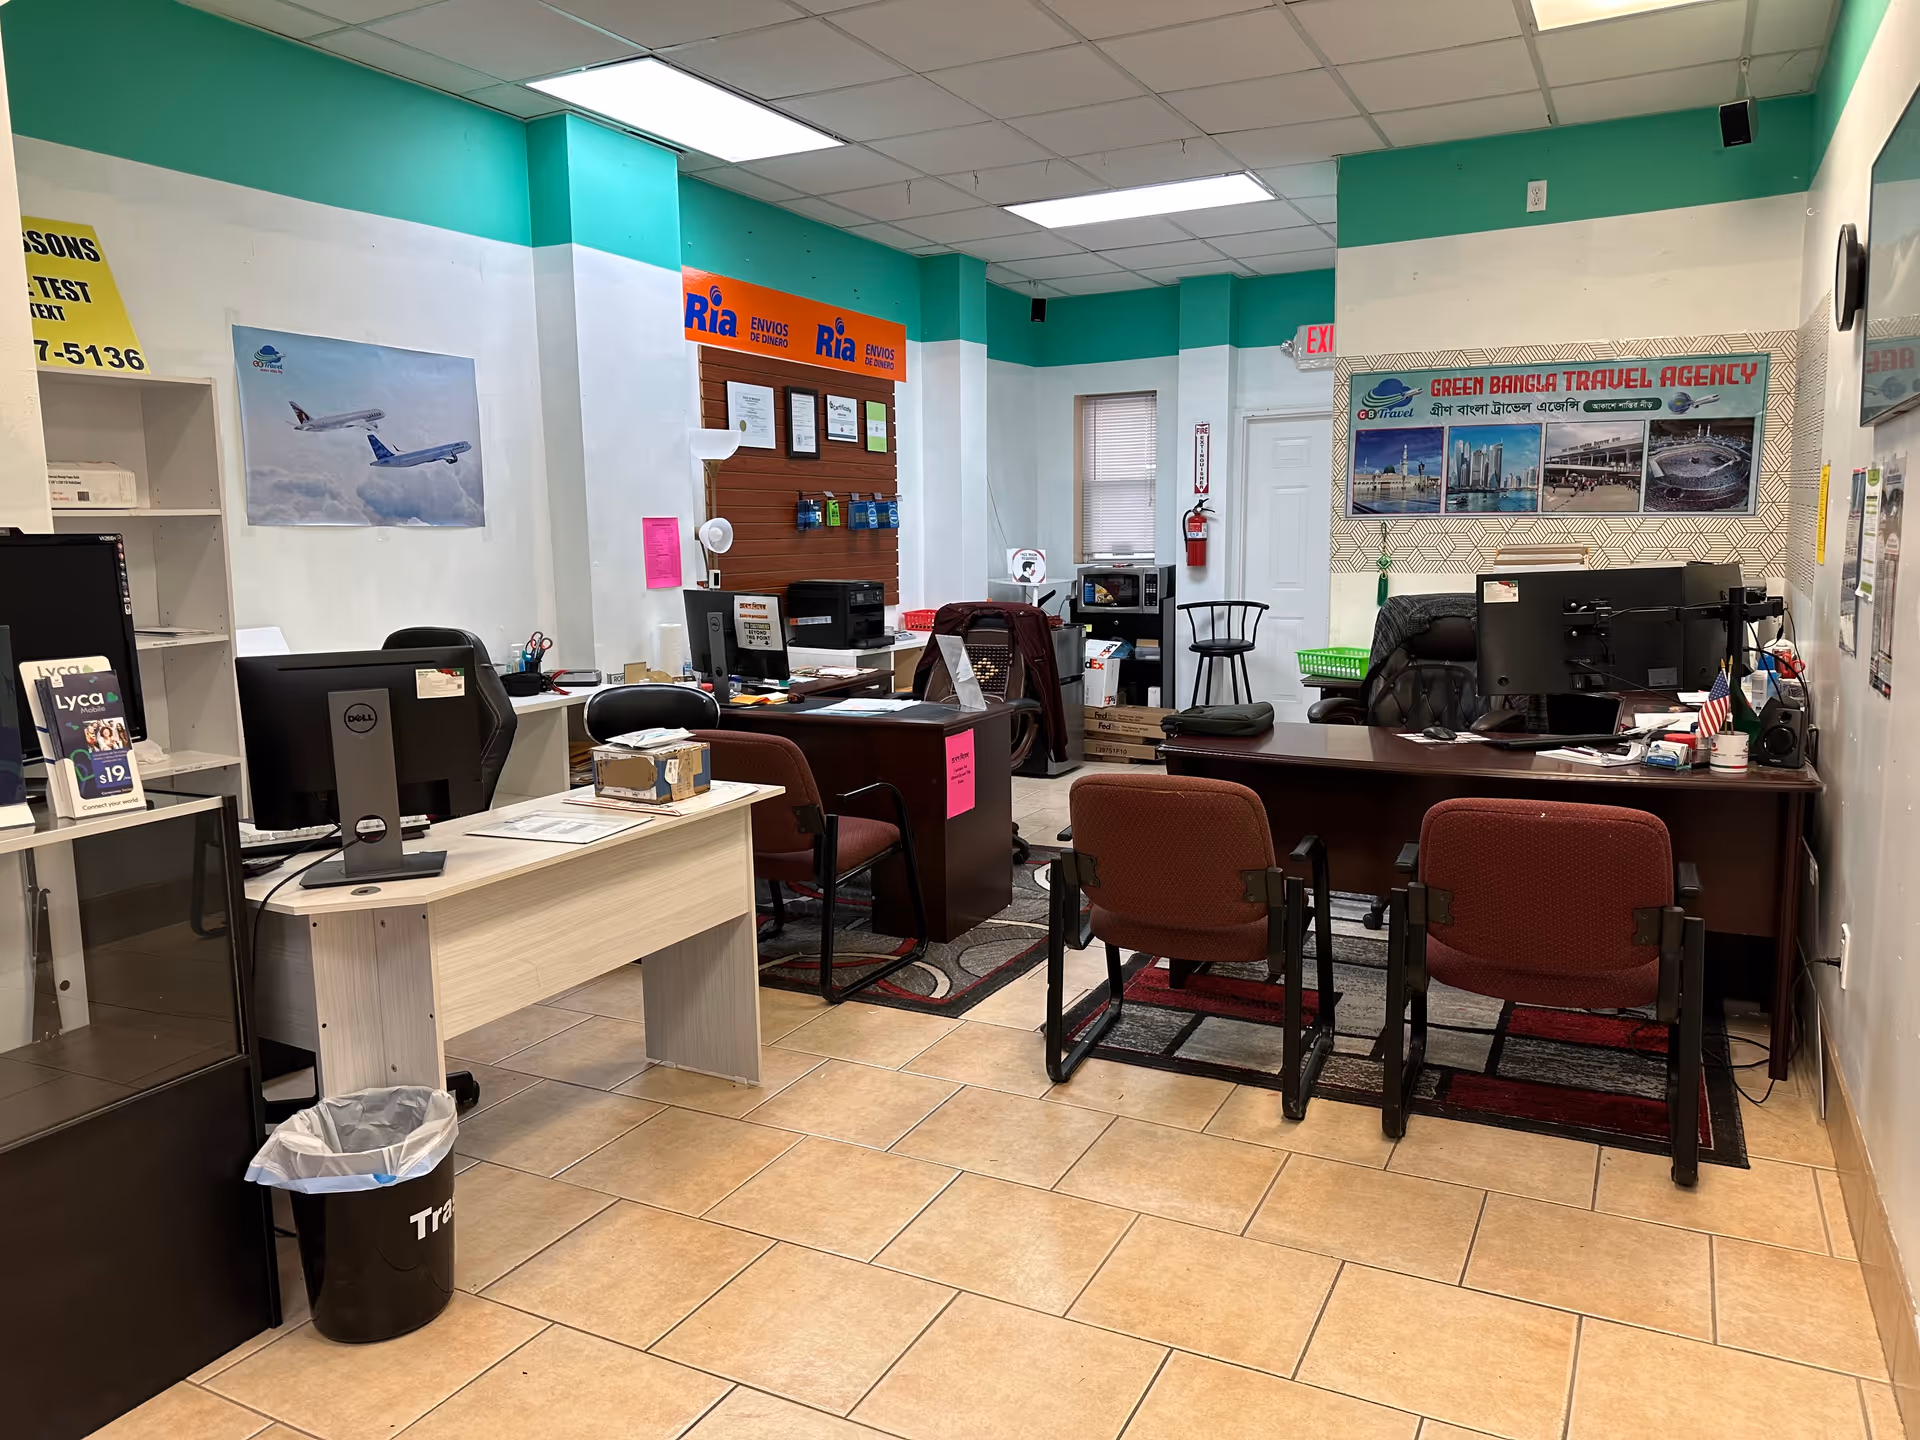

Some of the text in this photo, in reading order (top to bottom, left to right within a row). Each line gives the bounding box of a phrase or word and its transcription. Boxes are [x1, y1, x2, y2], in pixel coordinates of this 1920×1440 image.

[32, 275, 92, 303] TEST
[684, 286, 738, 338] Ria
[751, 317, 789, 337] ENVIOS
[750, 332, 789, 348] DE DINERO
[816, 317, 856, 362] Ria
[865, 343, 895, 361] ENVIOS
[865, 357, 895, 370] DE DINERO
[1430, 363, 1758, 397] GREEN BANGLA TRAVEL AGENCY
[1359, 408, 1415, 419] GB Travel
[1456, 403, 1489, 416] বাংলা
[1491, 400, 1532, 417] ট্রাভেল
[1536, 397, 1581, 412] এজেন্সি
[55, 692, 105, 711] Lyca
[80, 706, 106, 714] Mobile
[347, 714, 374, 722] DELL
[99, 765, 125, 784] $19
[82, 797, 139, 811] Connect your world
[410, 1193, 455, 1241] Tra
